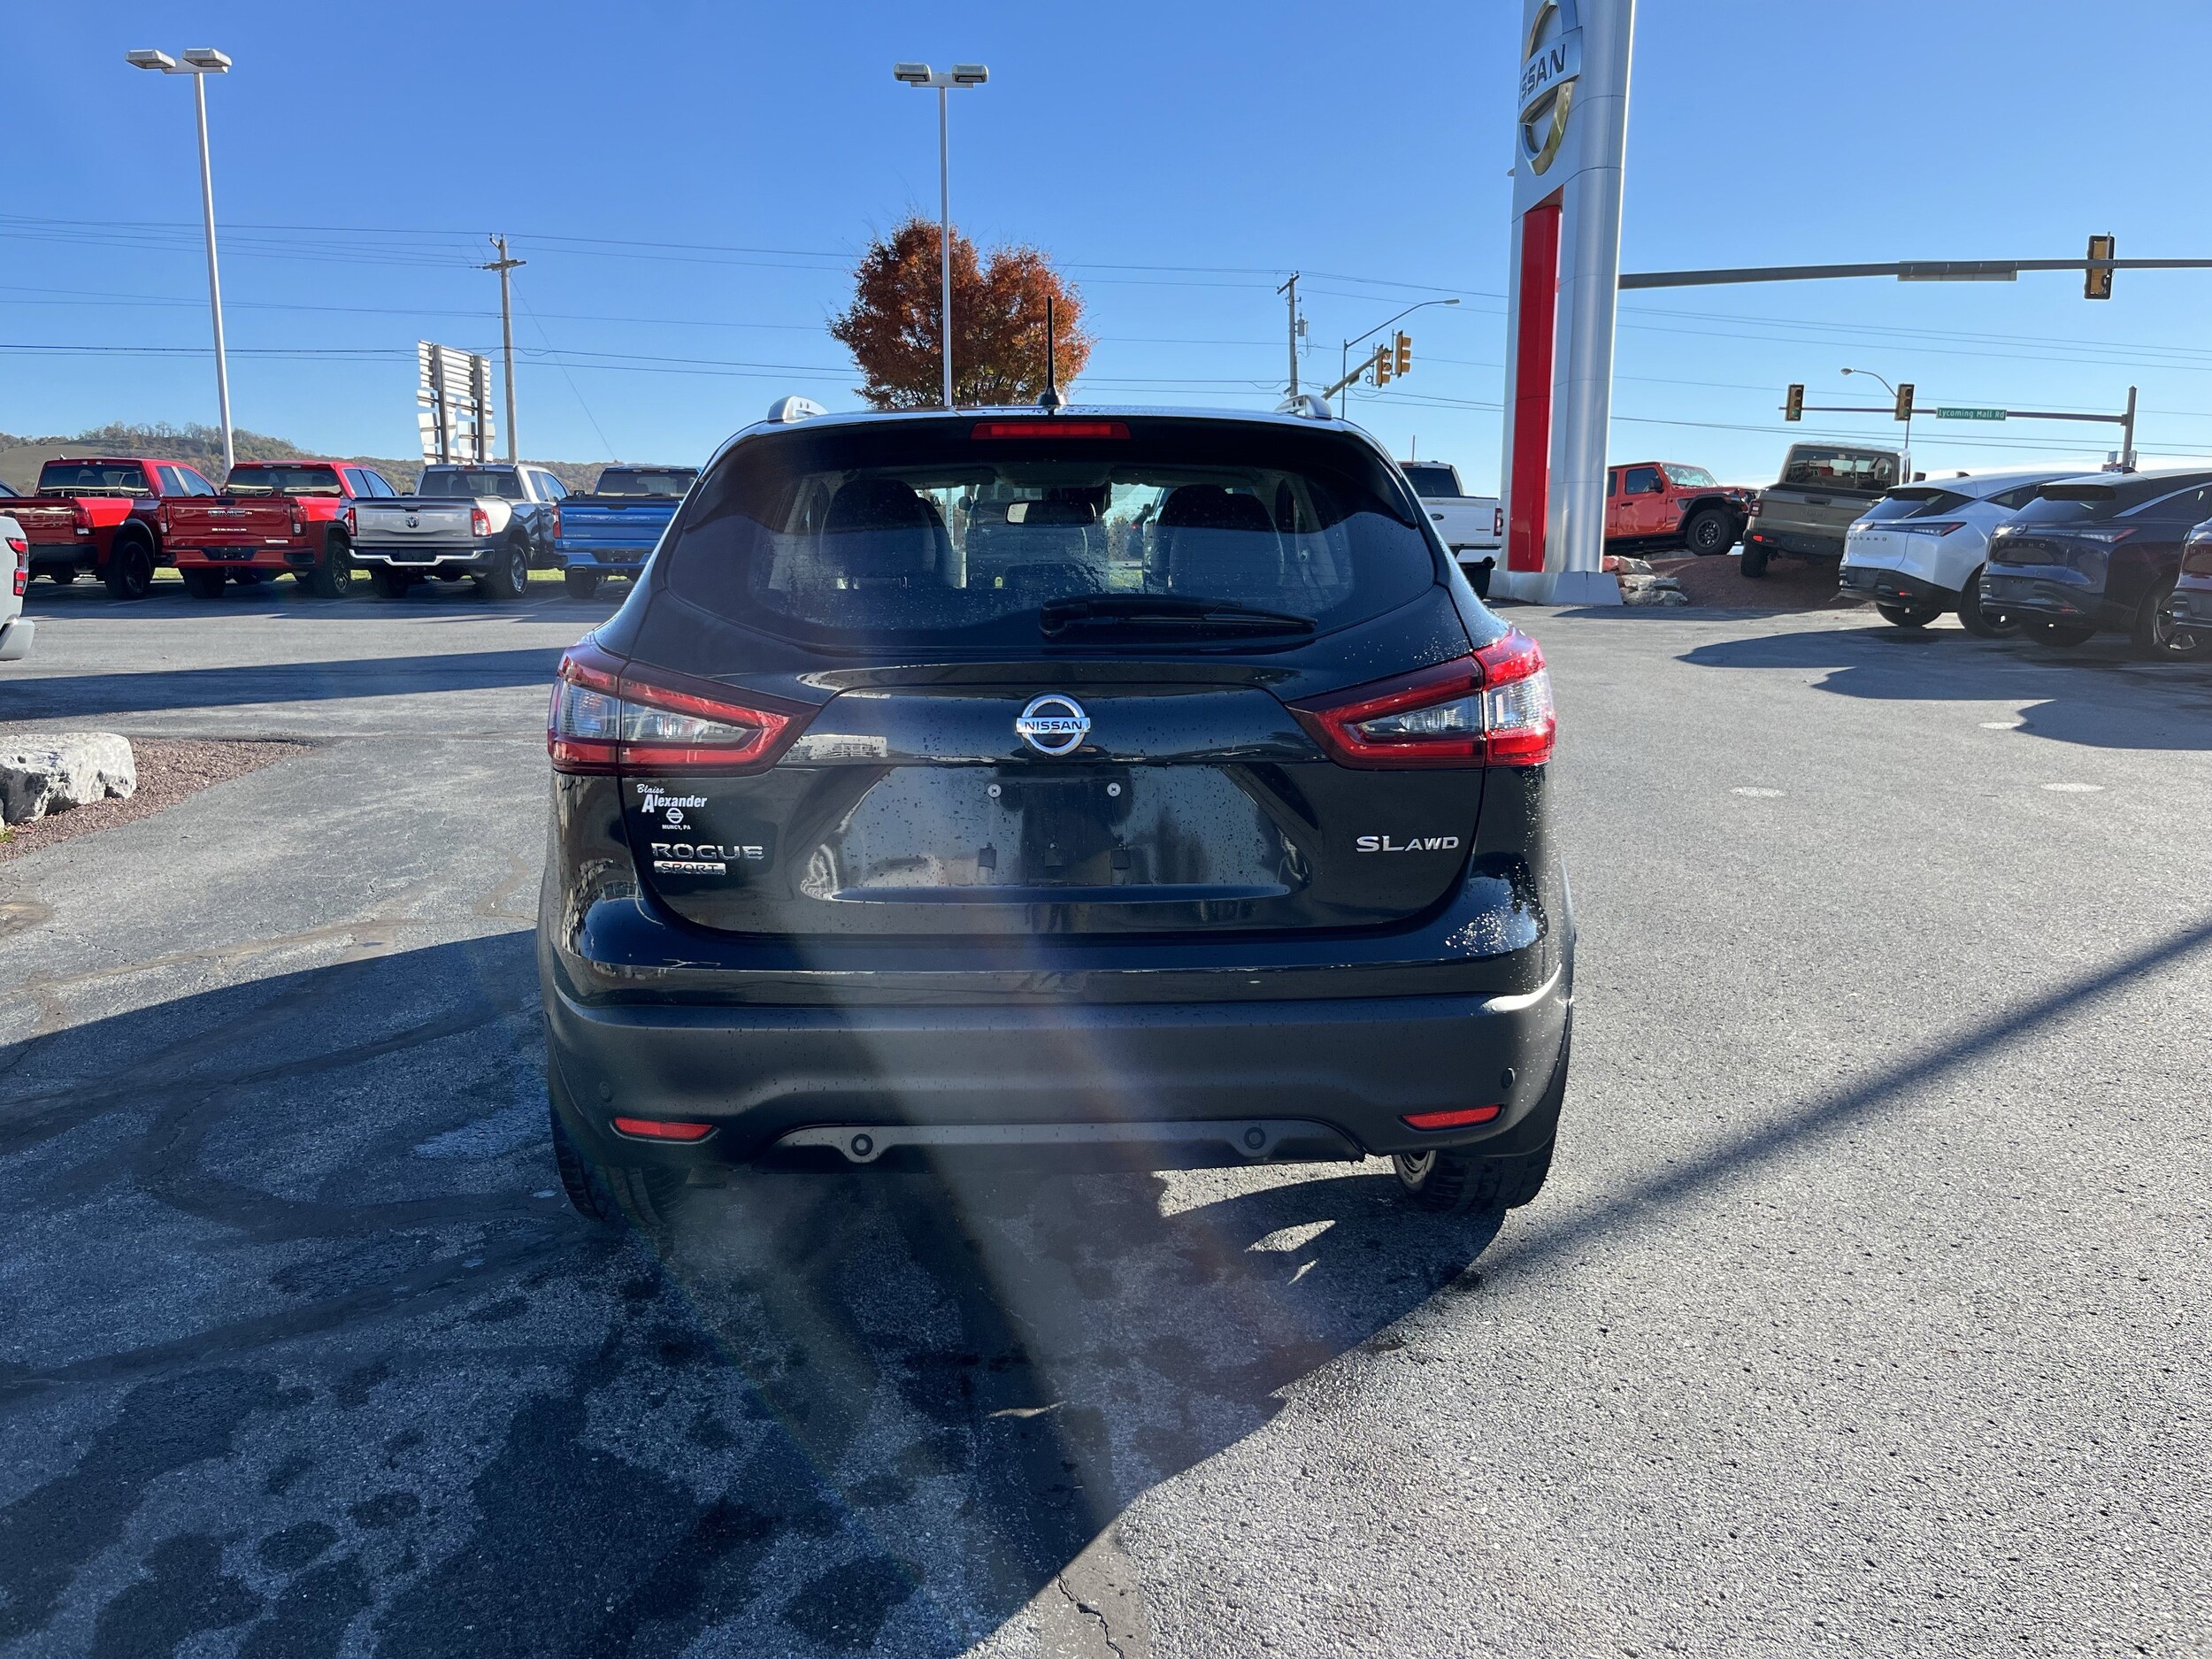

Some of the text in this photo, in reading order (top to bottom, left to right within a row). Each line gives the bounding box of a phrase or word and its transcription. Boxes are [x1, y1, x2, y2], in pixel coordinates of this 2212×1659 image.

[1939, 409, 1974, 419] Lycoming
[1025, 721, 1082, 730] NISSAN
[636, 783, 664, 794] Blaise
[641, 794, 707, 812] Alexander
[650, 842, 764, 860] ROGUE
[660, 863, 719, 874] SPORT
